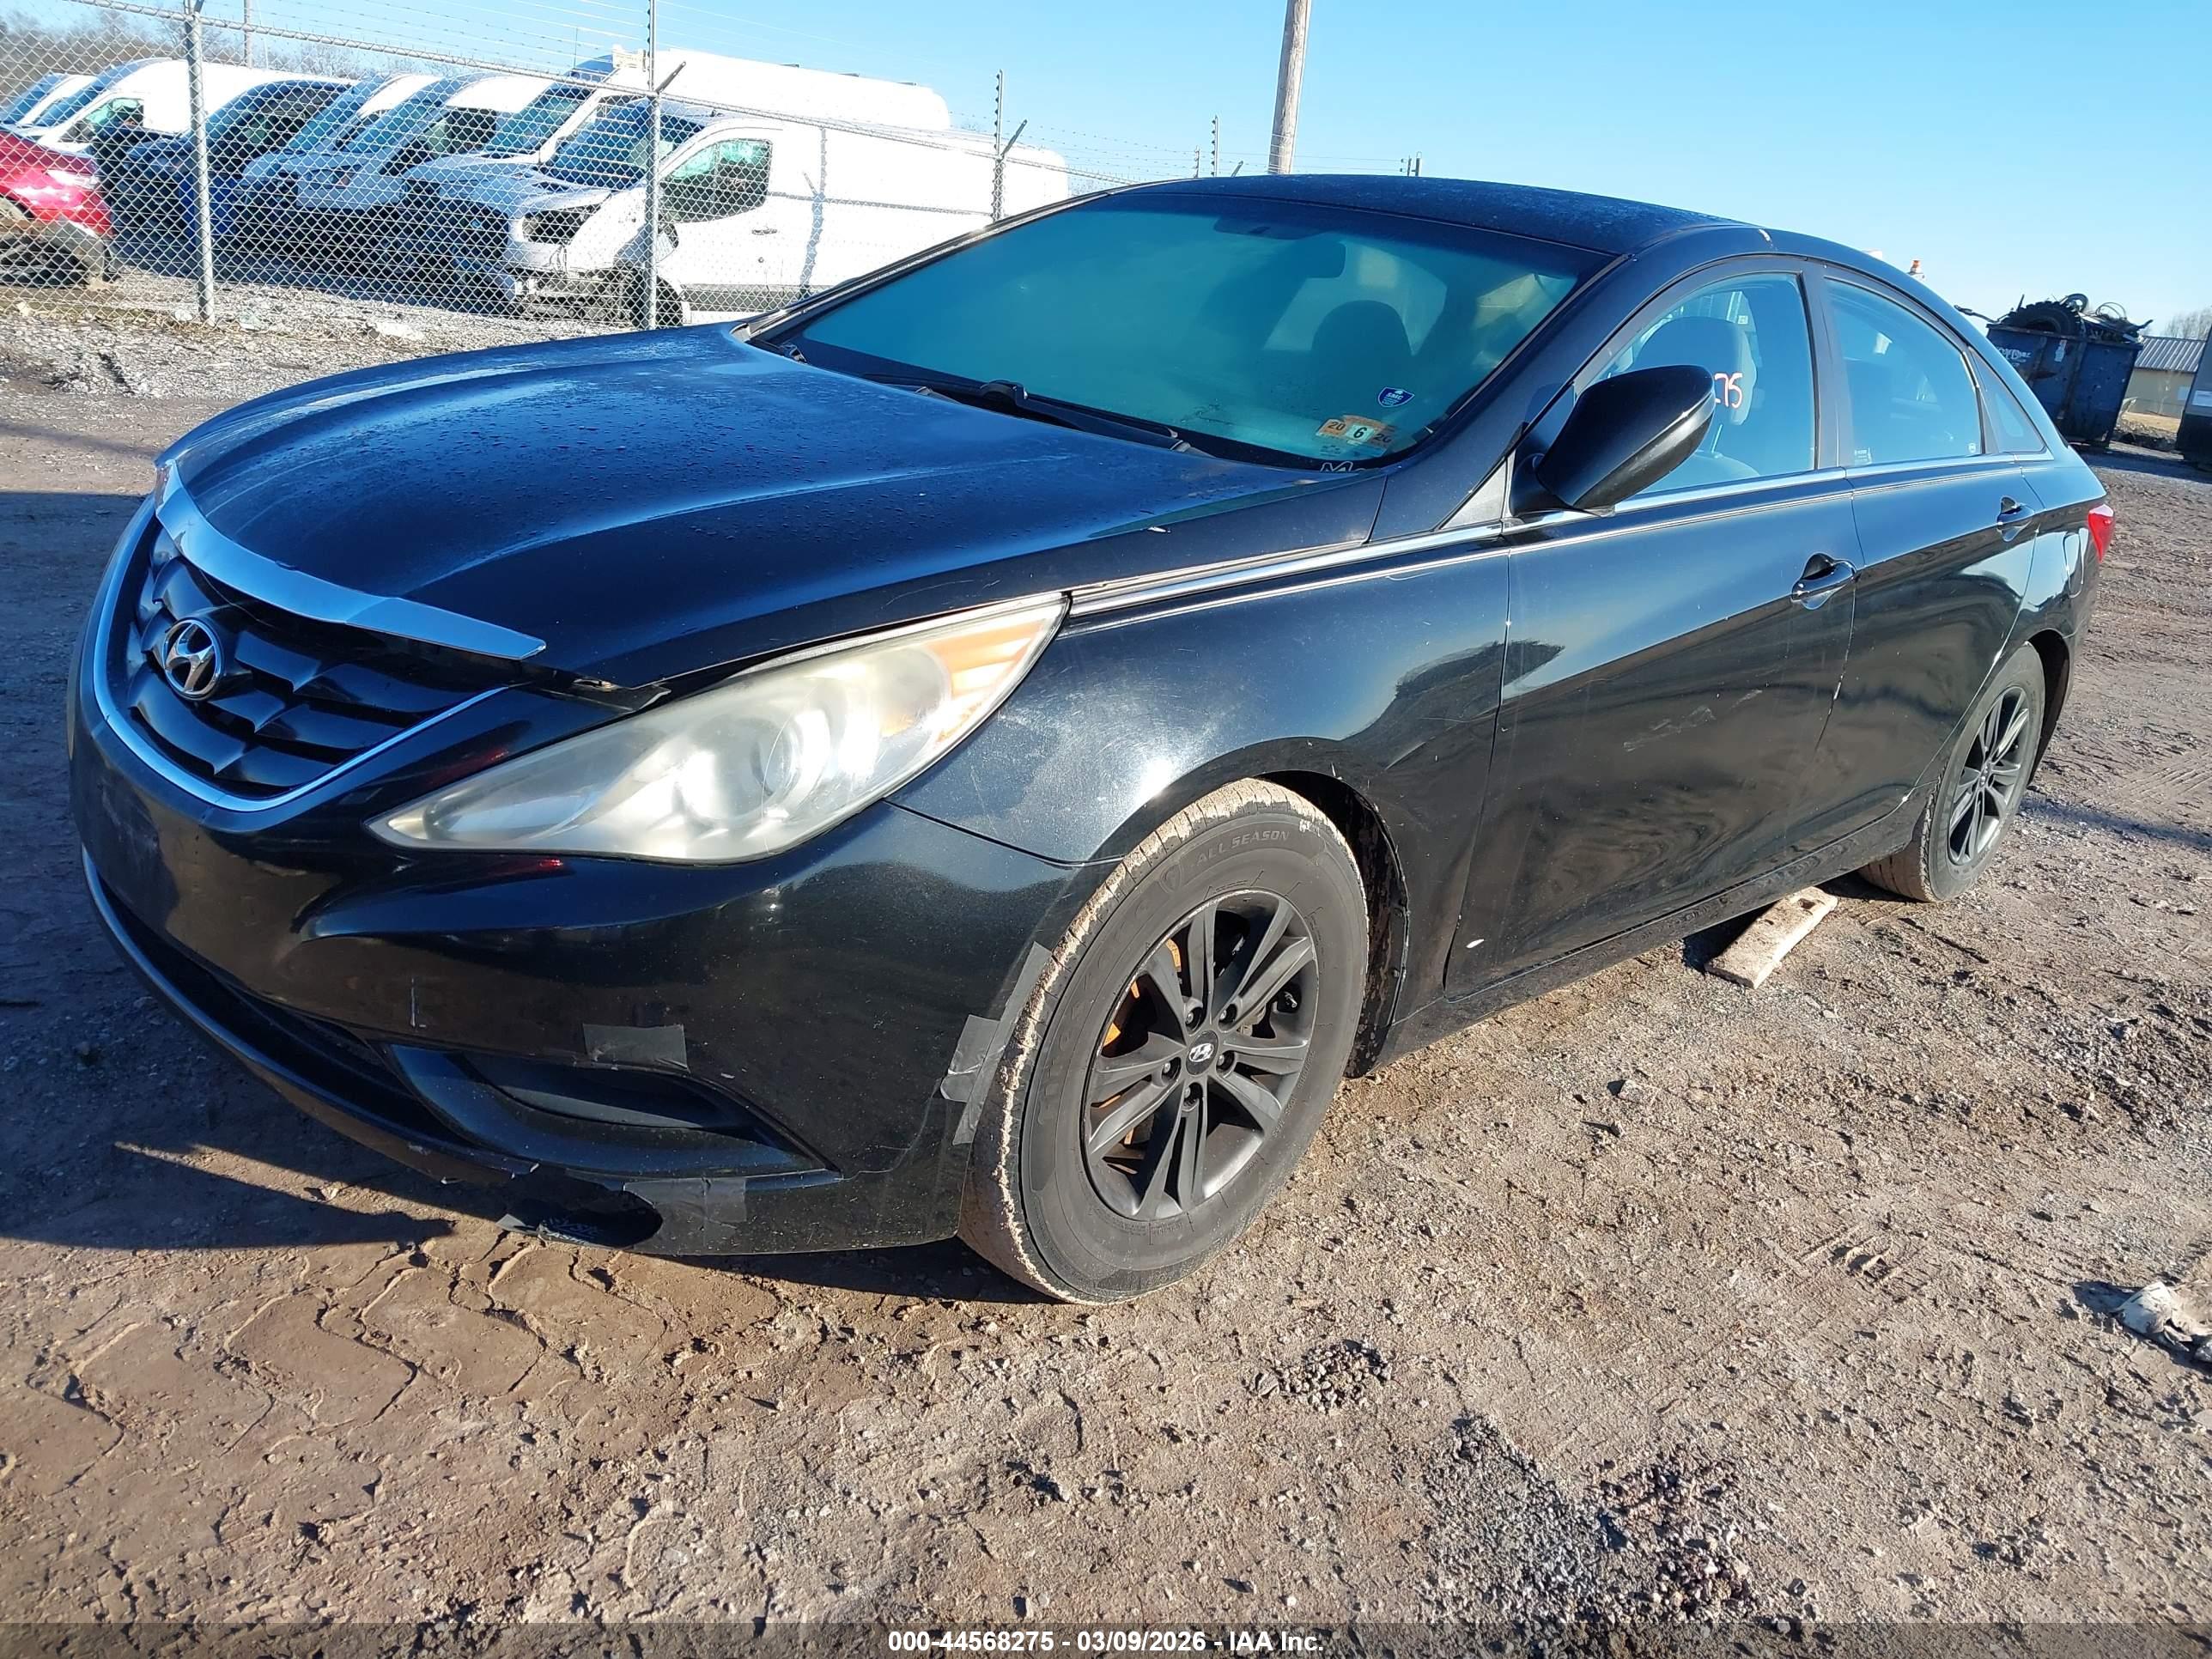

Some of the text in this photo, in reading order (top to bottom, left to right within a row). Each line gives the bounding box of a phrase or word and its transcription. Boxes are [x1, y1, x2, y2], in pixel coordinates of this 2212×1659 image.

[1714, 372, 1743, 409] 75
[1328, 421, 1346, 431] 20
[1352, 427, 1368, 439] 6
[1197, 830, 1290, 862] ALL SEASON
